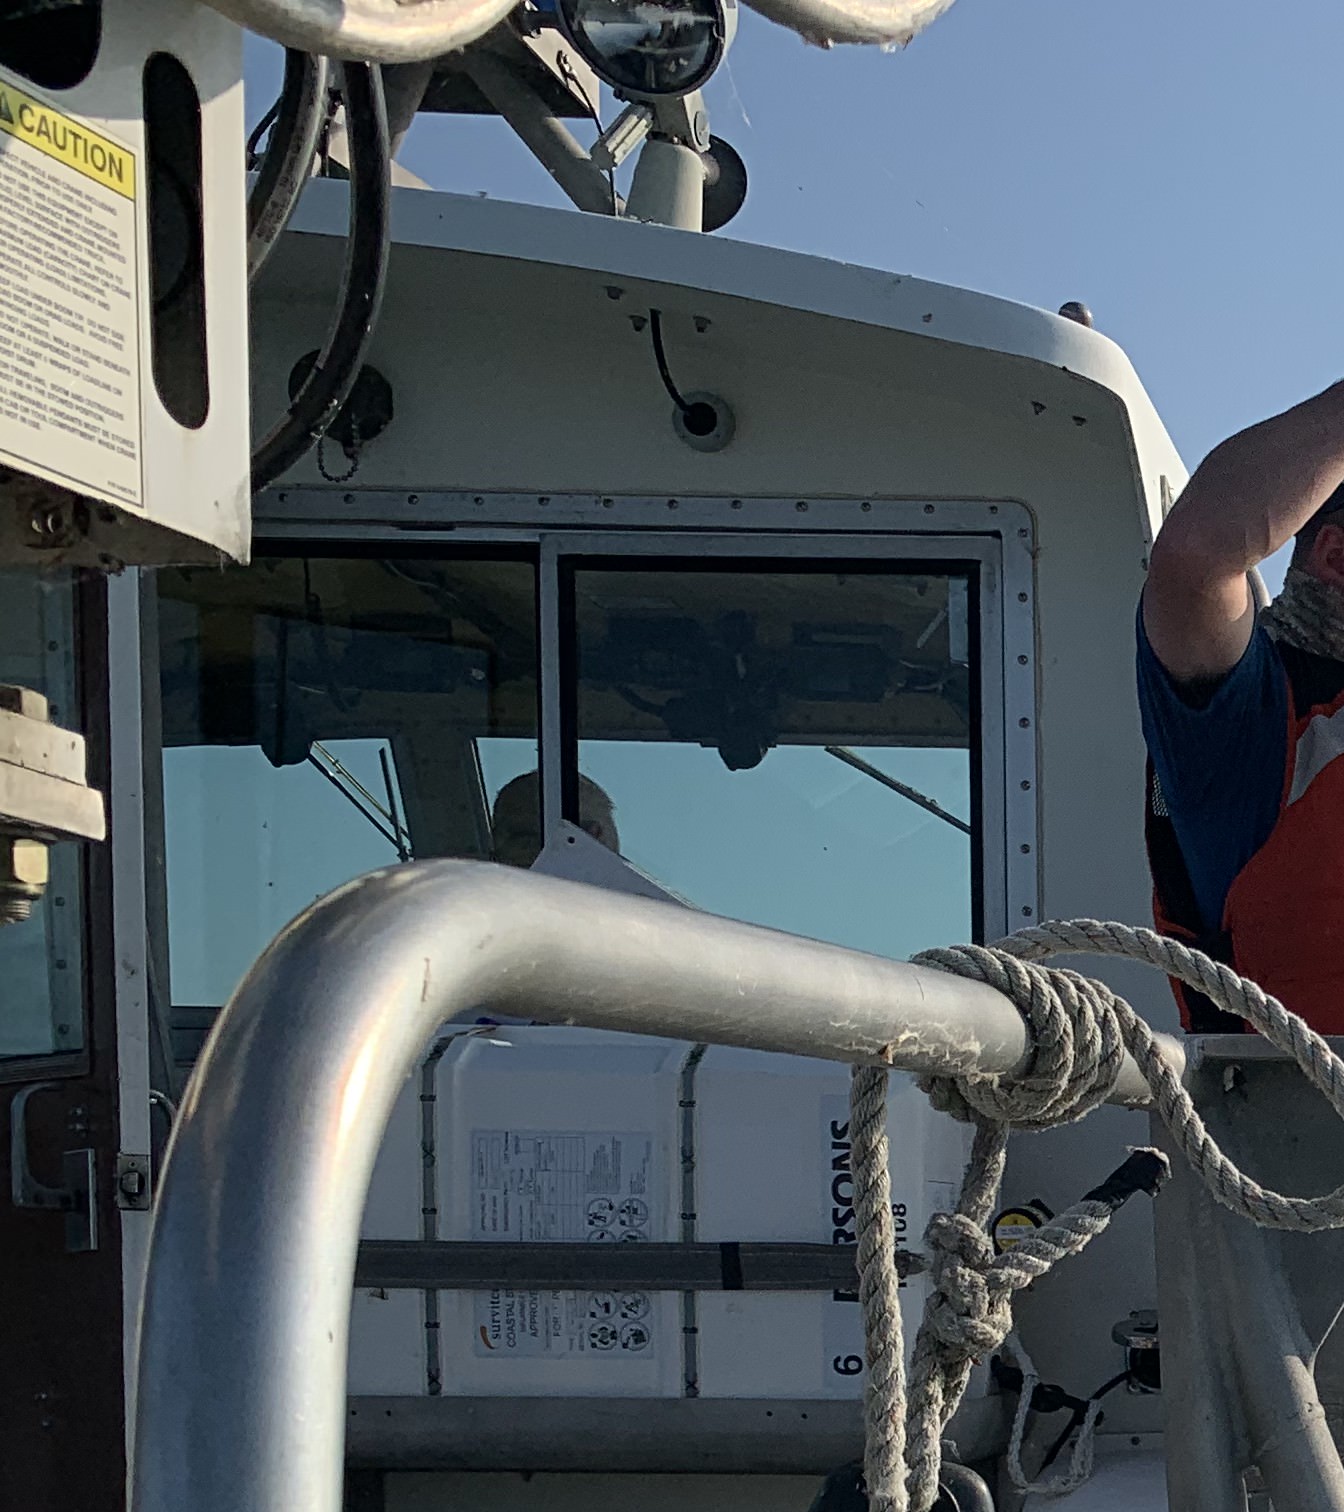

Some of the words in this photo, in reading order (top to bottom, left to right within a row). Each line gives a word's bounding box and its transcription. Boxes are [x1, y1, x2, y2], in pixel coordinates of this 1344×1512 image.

[19, 103, 123, 183] CAUTION
[831, 1120, 860, 1302] PRSONS
[505, 1303, 516, 1348] COASTAL
[529, 1289, 539, 1337] APPROVE
[834, 1355, 863, 1376] 6
